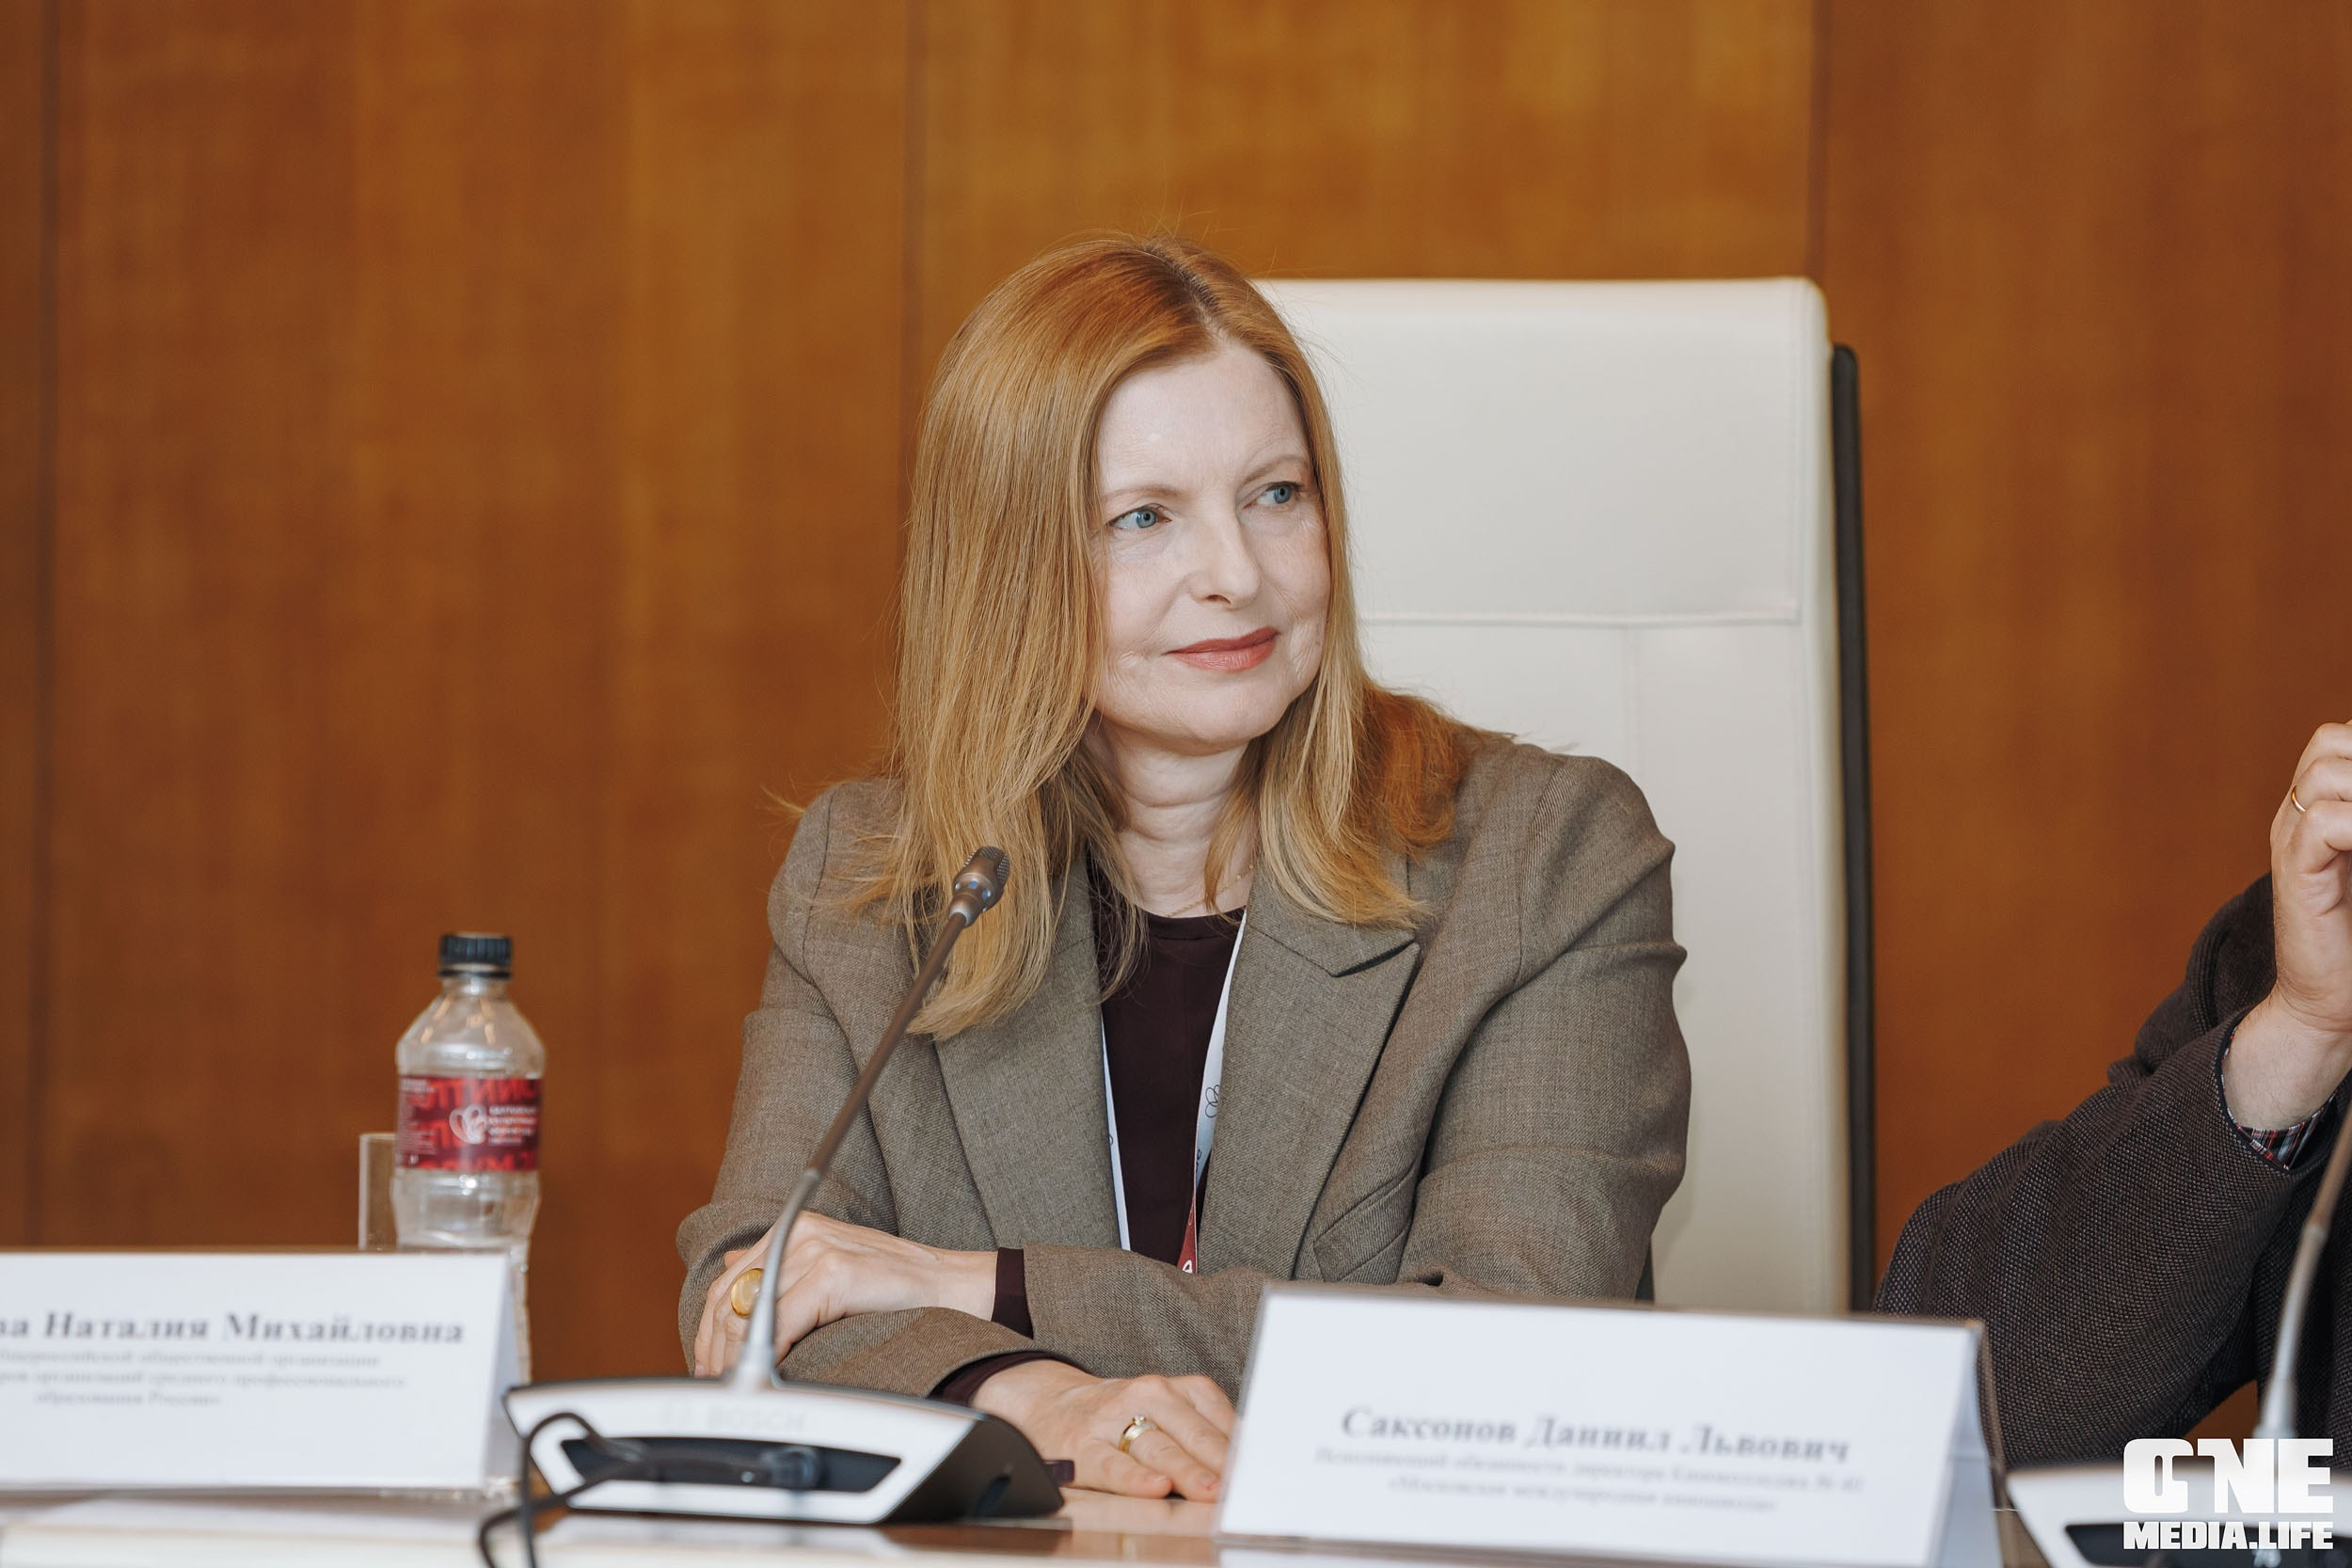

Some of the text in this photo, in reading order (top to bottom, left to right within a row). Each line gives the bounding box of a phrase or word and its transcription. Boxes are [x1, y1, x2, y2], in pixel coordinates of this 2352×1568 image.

[44, 1311, 209, 1340] Наталия
[225, 1313, 464, 1345] Михайловна
[1342, 1405, 1850, 1464] Саксонов Даниил Львович
